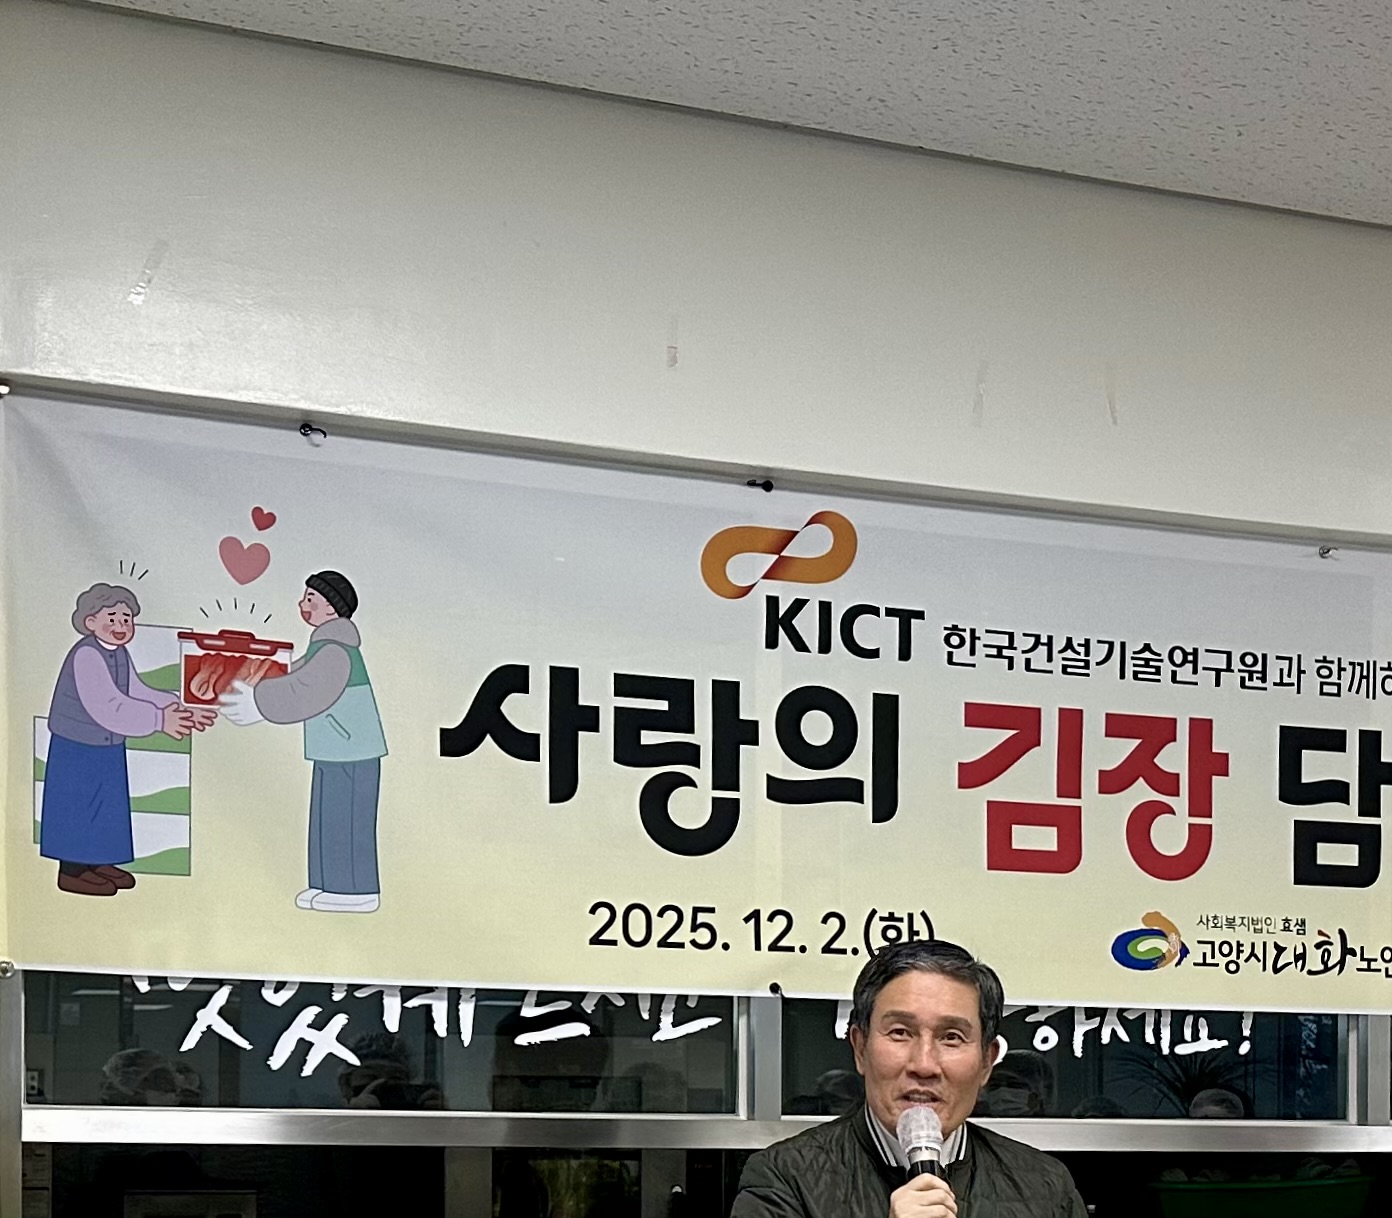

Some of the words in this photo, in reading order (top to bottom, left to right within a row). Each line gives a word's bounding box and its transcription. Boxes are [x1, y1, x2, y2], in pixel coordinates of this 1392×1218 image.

[765, 594, 926, 662] KICT
[942, 623, 1306, 695] 한국건설기술연구원과
[440, 663, 900, 857] 사랑의
[957, 701, 1230, 881] 김장
[588, 901, 731, 951] 2025.
[1196, 913, 1277, 934] 사회복지법인
[1280, 916, 1306, 936] 효샘
